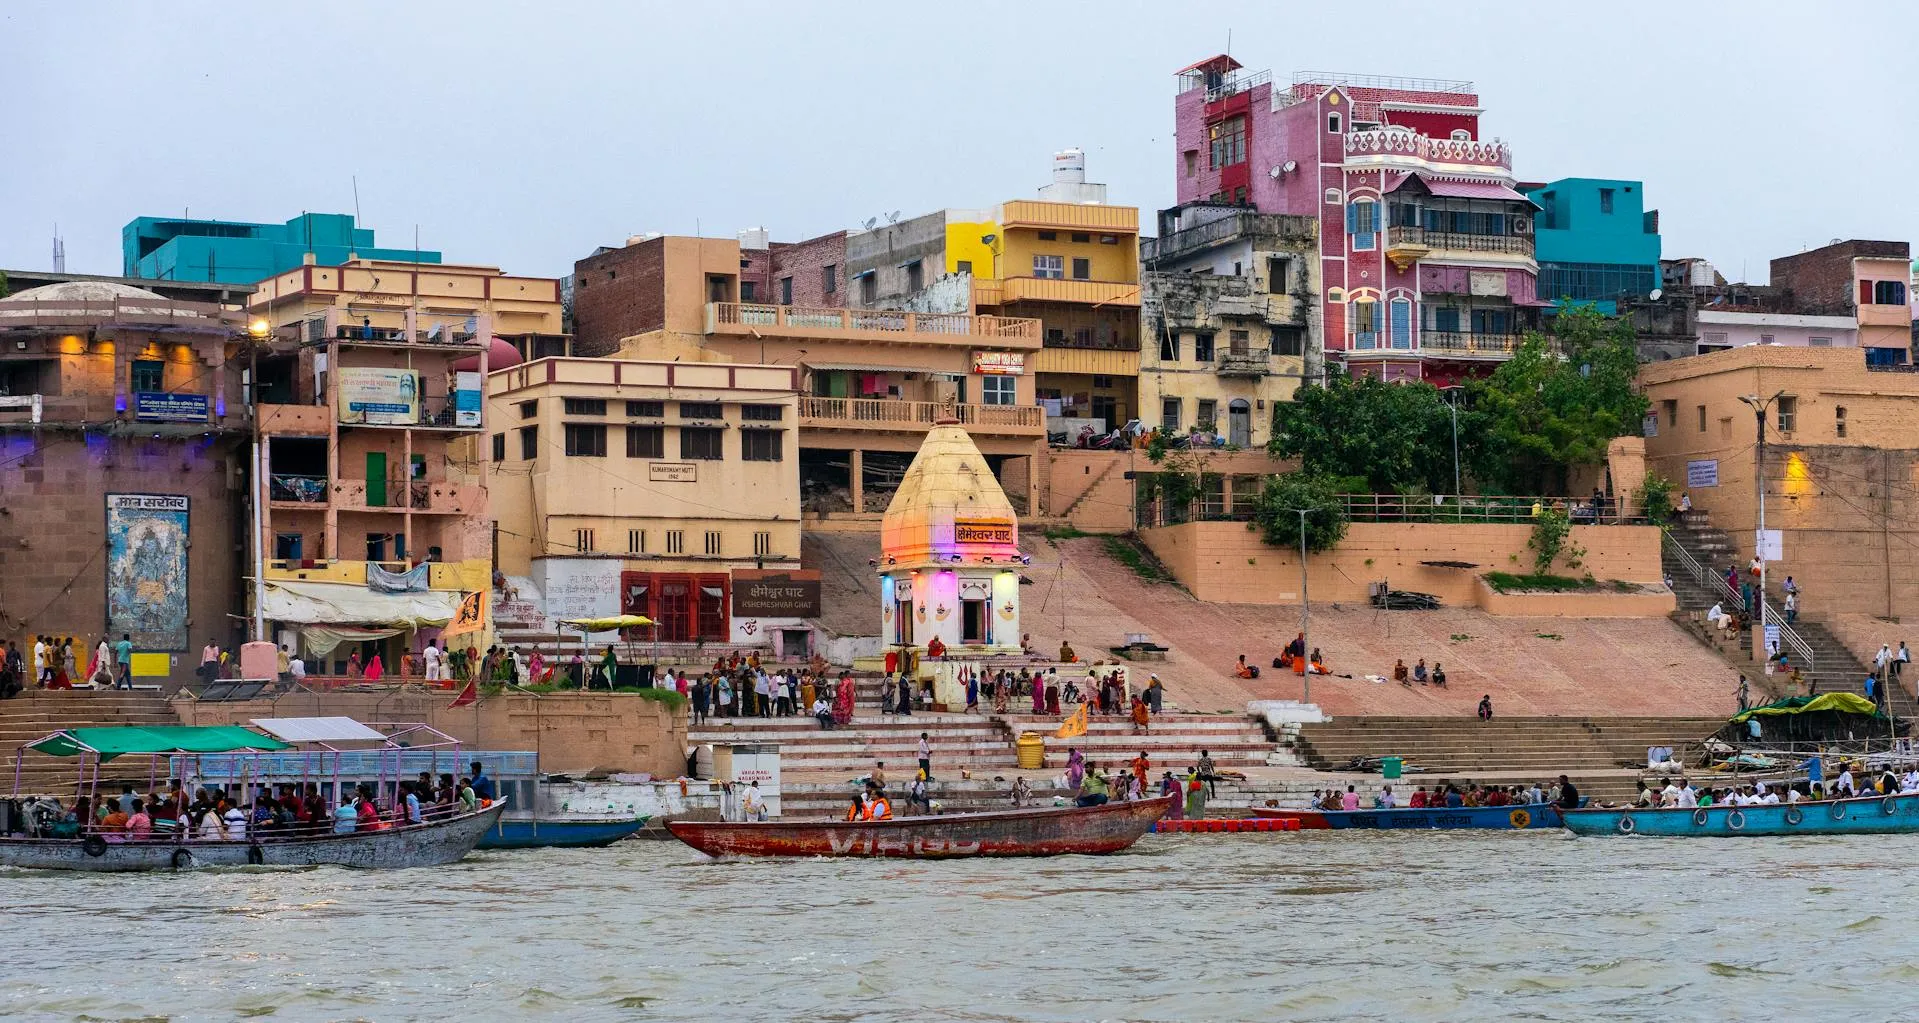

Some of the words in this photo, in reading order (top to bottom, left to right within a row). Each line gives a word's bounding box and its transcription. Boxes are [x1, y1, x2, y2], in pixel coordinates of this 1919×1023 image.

[143, 496, 185, 508] सरोवर
[995, 530, 1010, 541] घाट
[750, 584, 784, 599] क्षेमेश्वर
[785, 587, 805, 598] घाट
[742, 601, 793, 609] KSHEMESHVAR
[794, 601, 812, 609] GHAT
